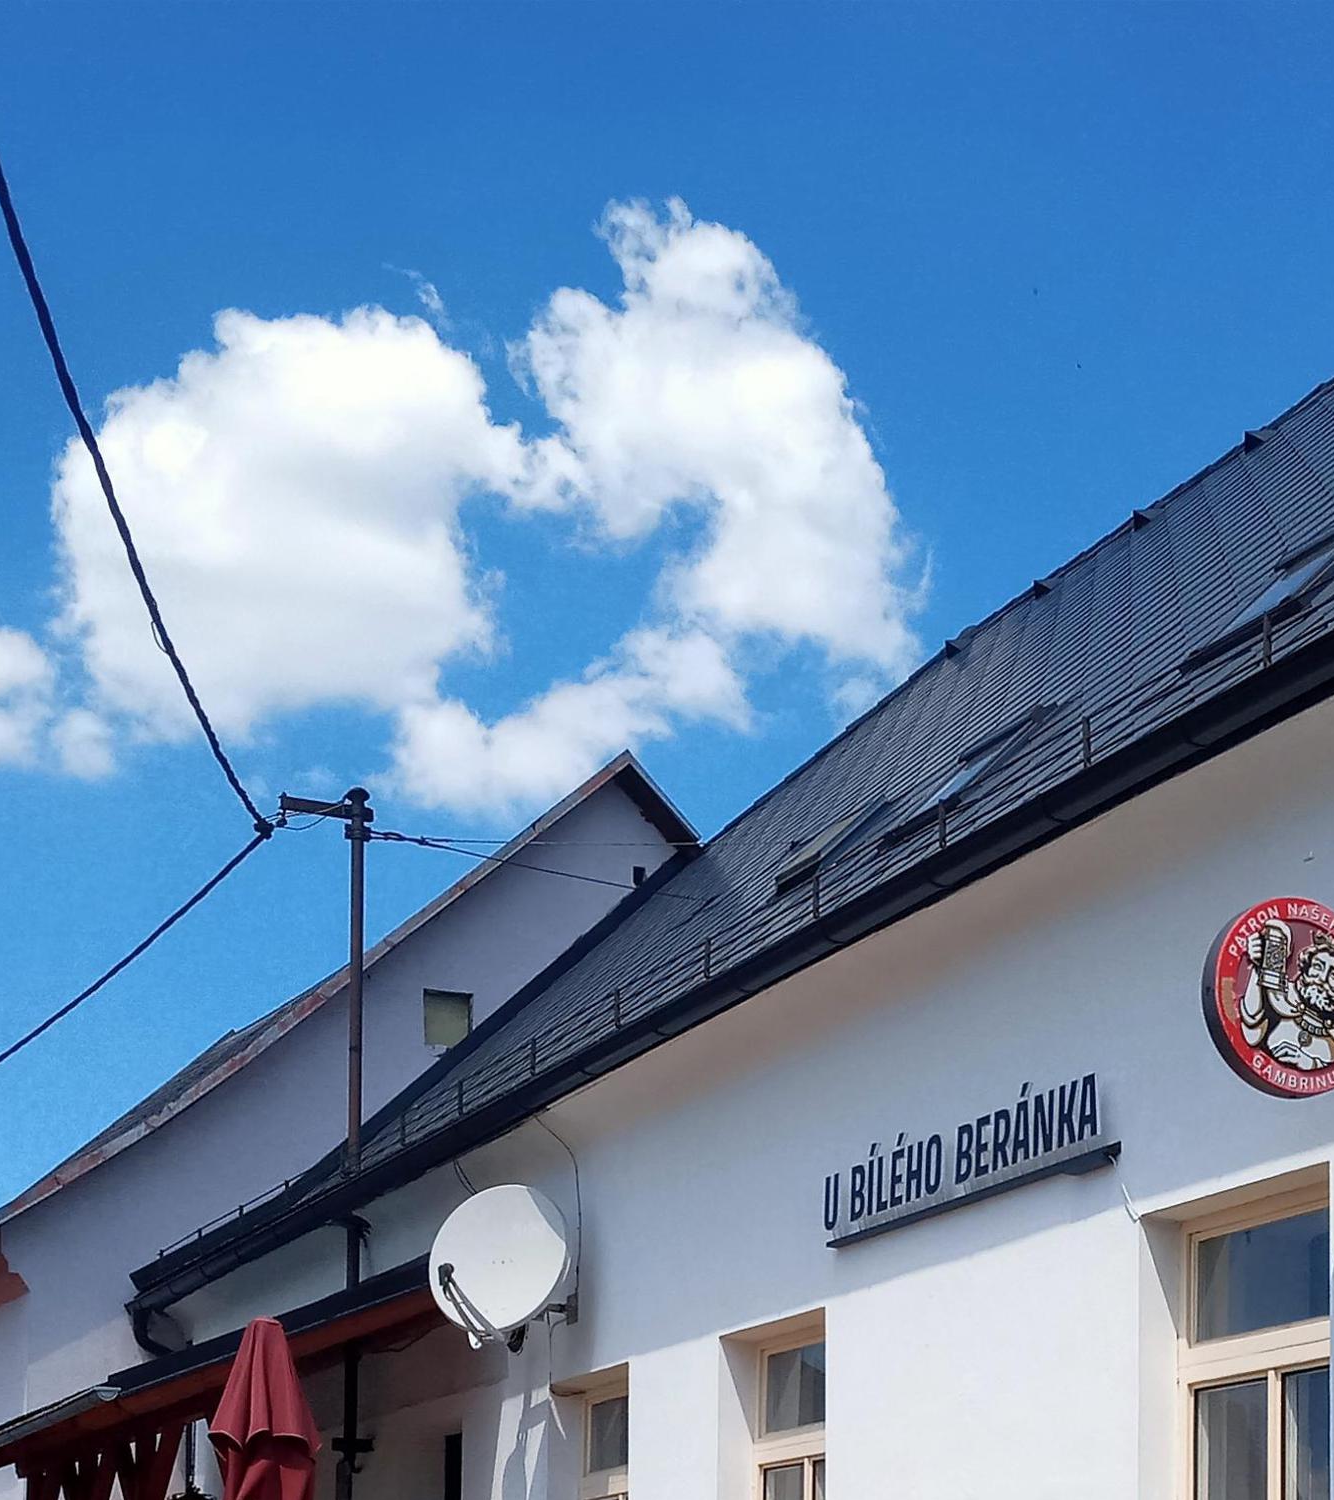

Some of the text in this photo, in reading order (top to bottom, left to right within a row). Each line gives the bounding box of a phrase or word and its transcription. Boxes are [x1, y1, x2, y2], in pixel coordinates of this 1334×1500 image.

[1228, 905, 1280, 957] PATRON
[824, 1072, 1098, 1231] U BÍLÉHO BERÁNKA
